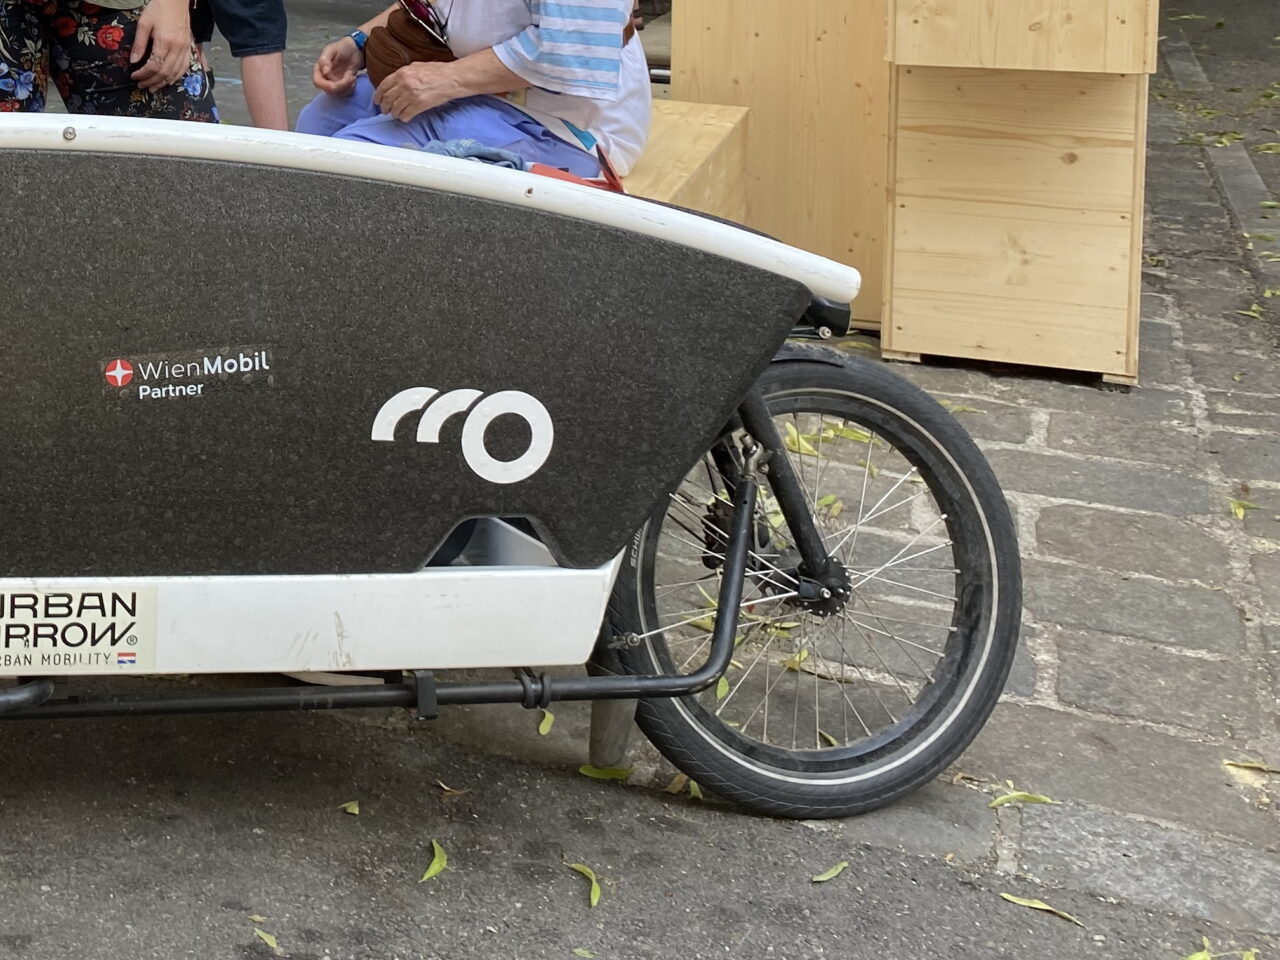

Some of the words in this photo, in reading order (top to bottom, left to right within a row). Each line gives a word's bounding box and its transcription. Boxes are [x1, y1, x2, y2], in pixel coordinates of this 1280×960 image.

[138, 351, 270, 380] WienMobil
[139, 383, 204, 400] Partner
[630, 528, 642, 568] SCHW
[40, 652, 112, 667] MOBILITY
